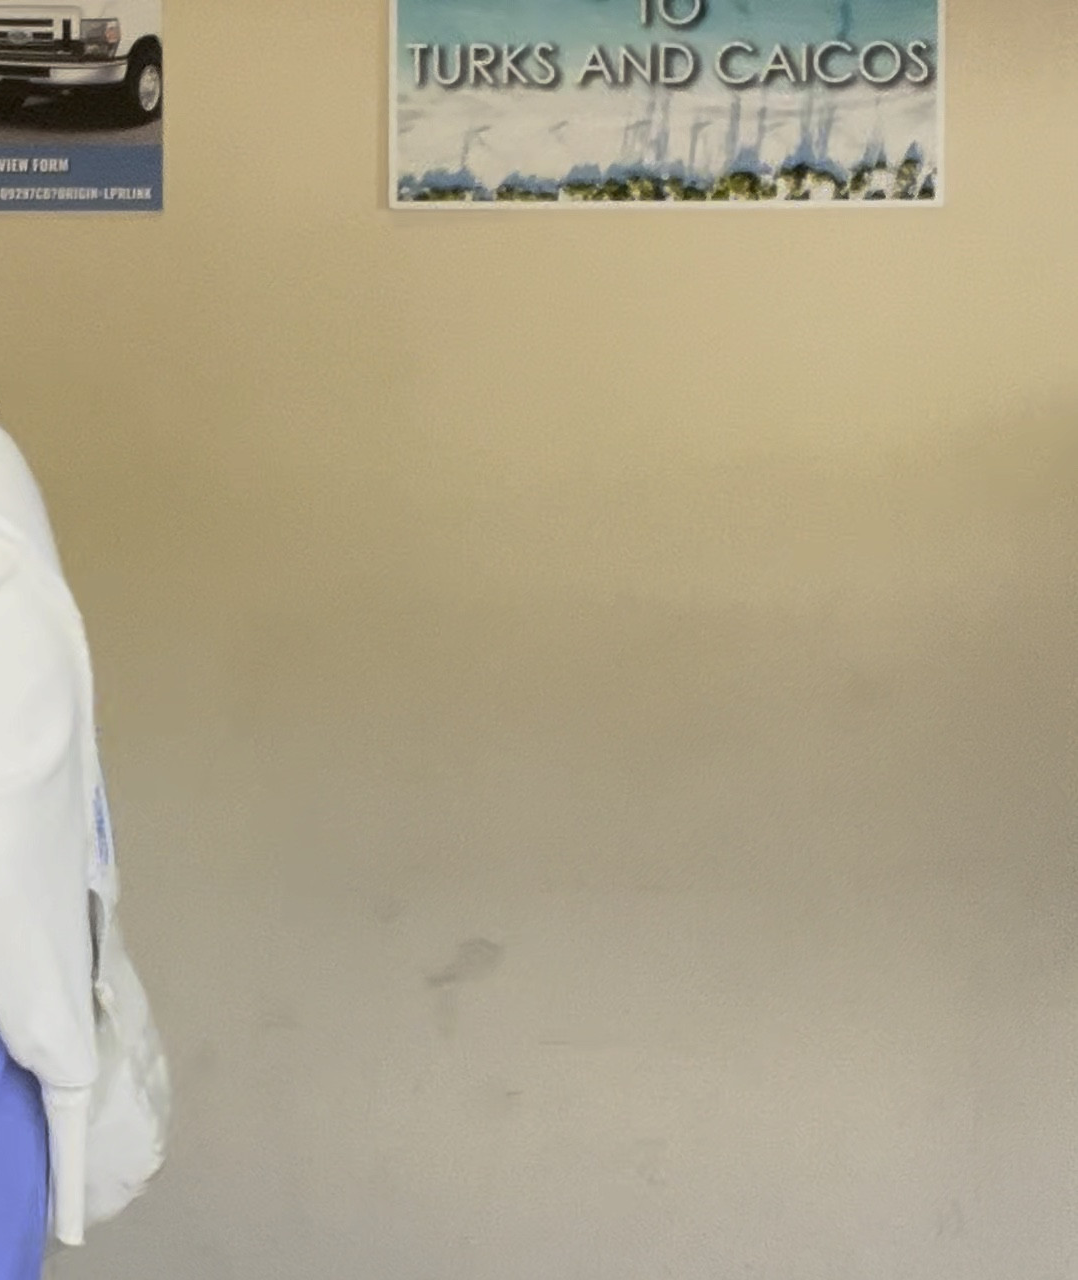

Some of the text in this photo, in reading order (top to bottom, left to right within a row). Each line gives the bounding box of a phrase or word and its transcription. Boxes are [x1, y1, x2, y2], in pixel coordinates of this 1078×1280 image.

[406, 40, 931, 86] TURKS AND CAICOS
[32, 158, 69, 173] FORM
